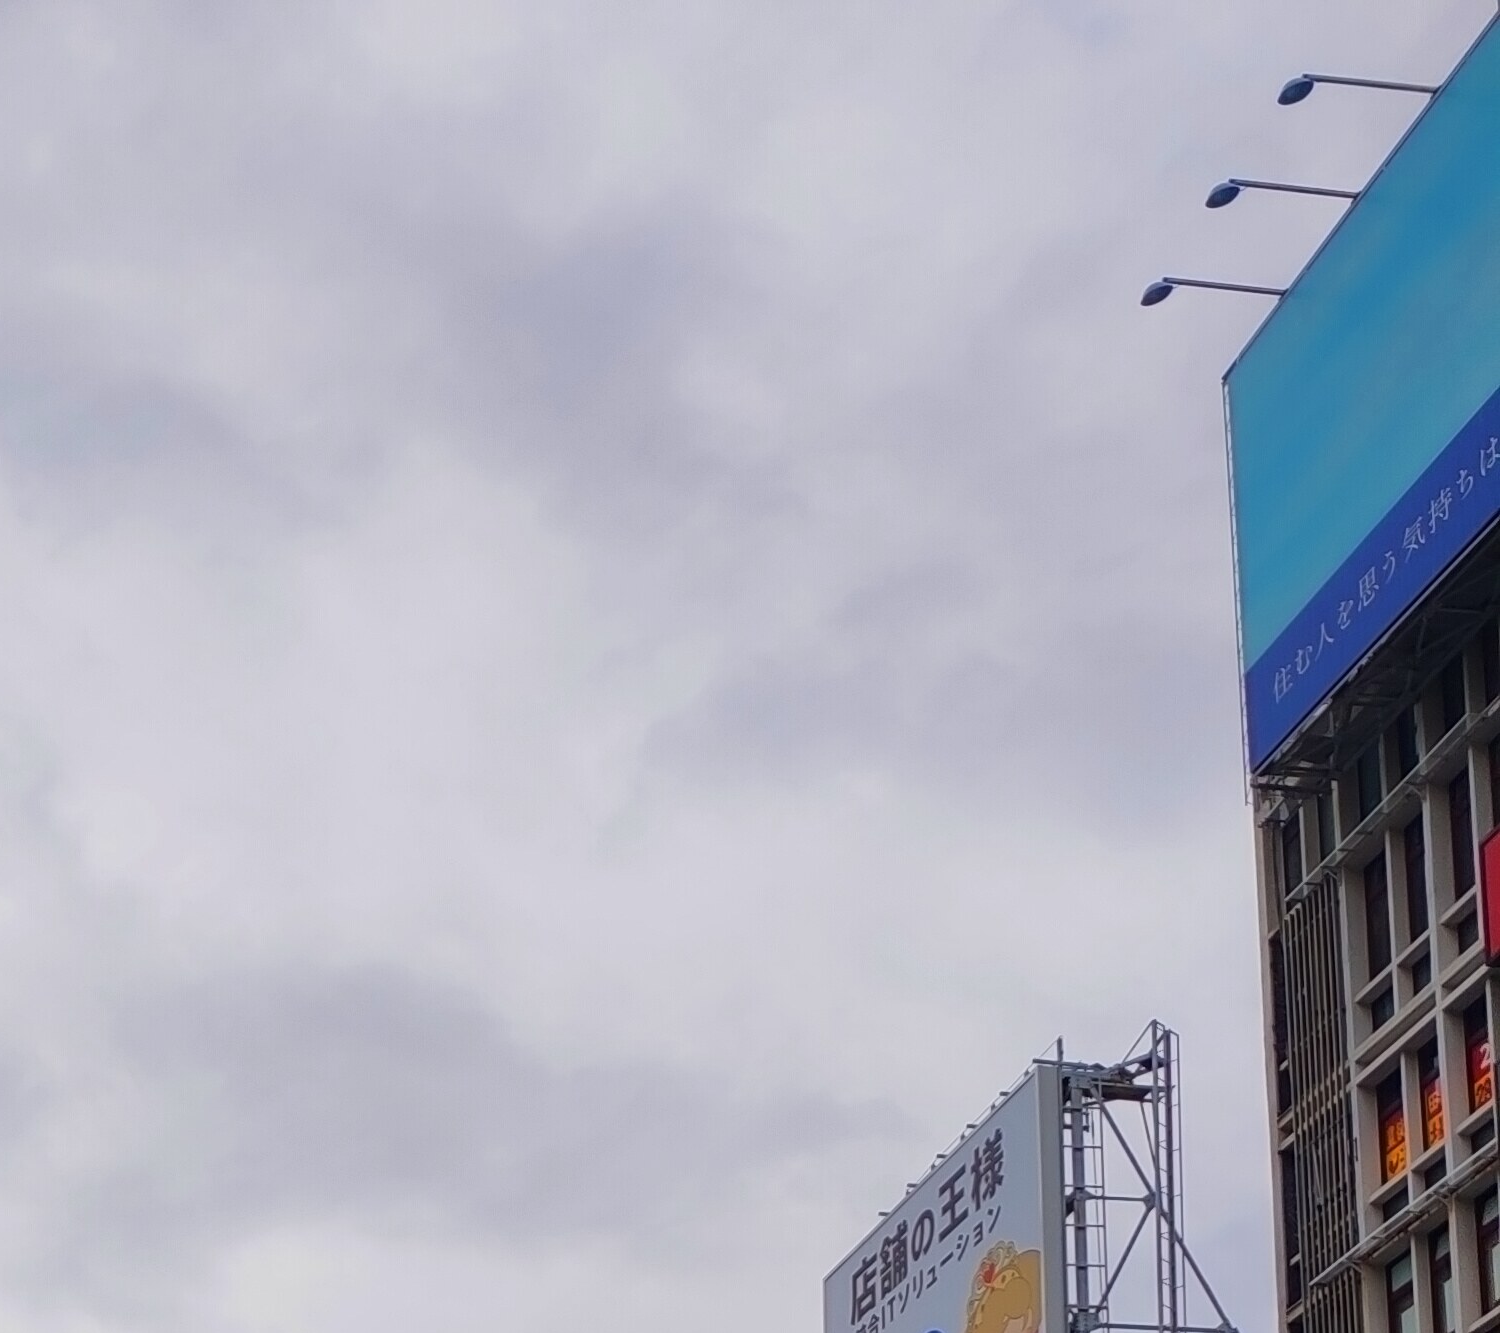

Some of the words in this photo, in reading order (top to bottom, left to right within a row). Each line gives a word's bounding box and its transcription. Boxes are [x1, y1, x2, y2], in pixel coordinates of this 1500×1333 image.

[850, 1128, 1005, 1327] 店舗の王様
